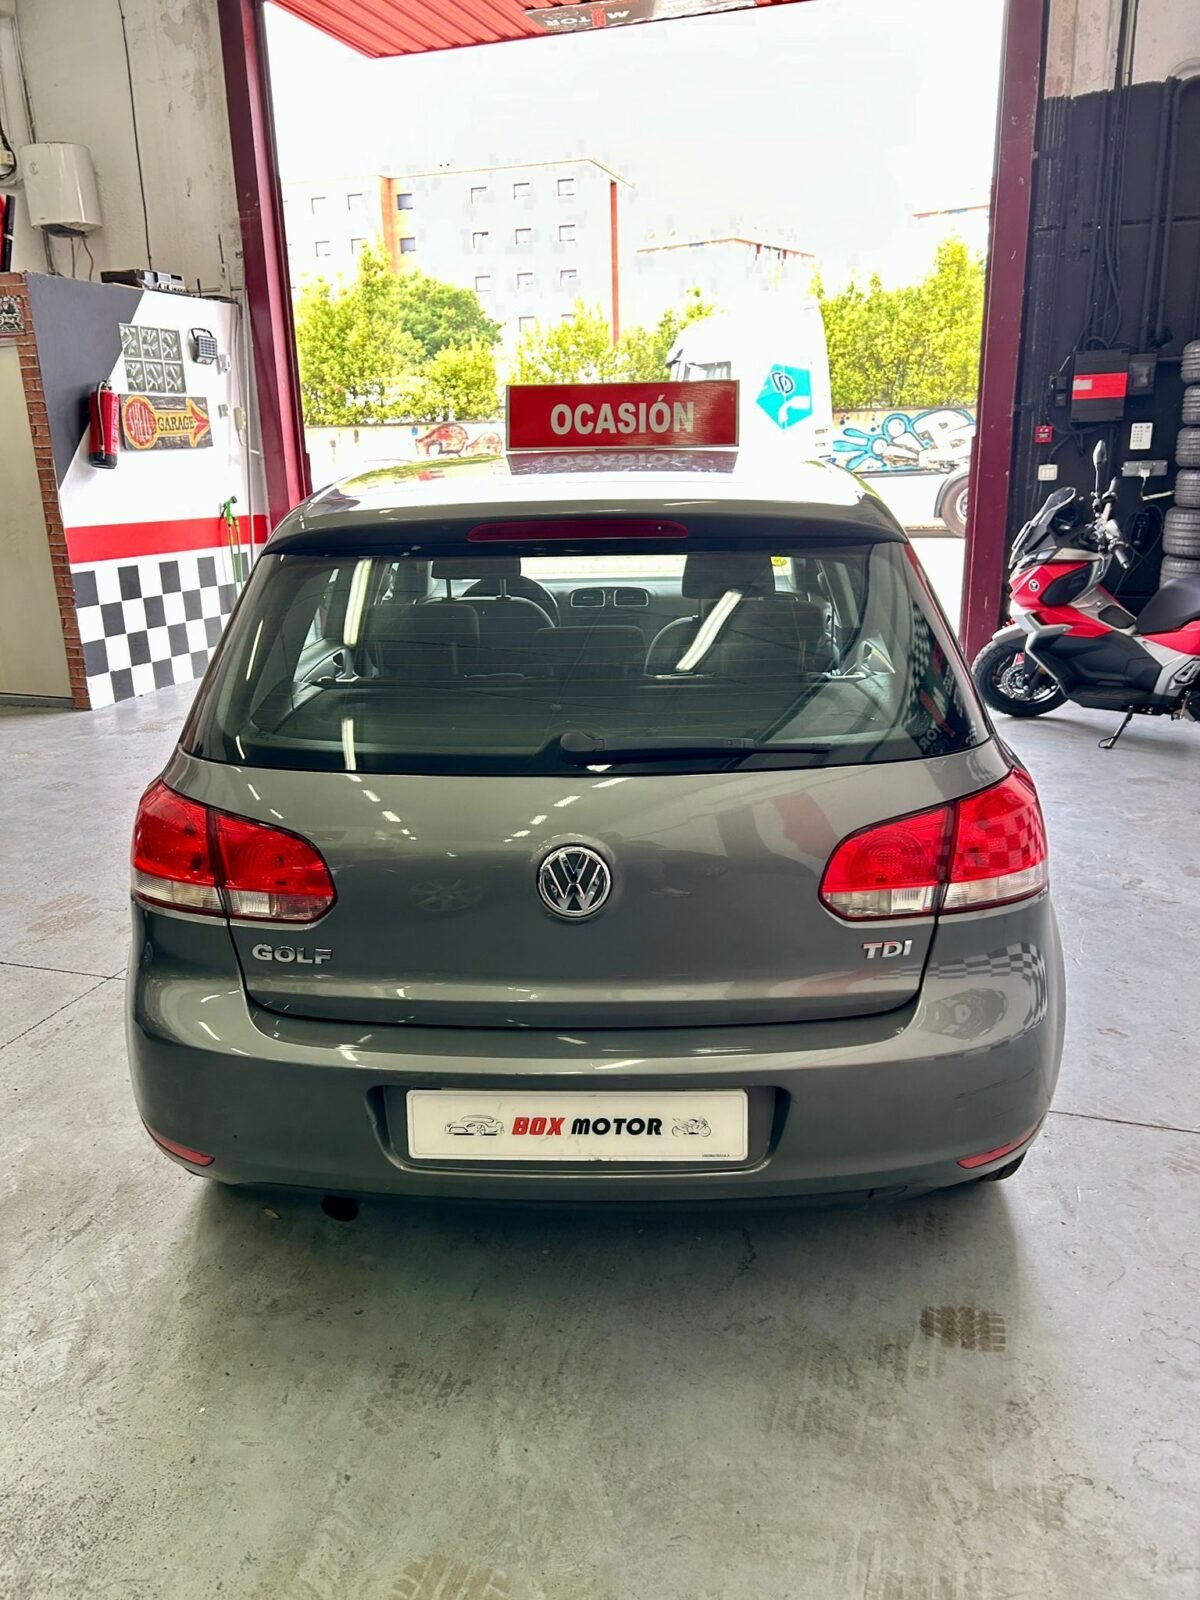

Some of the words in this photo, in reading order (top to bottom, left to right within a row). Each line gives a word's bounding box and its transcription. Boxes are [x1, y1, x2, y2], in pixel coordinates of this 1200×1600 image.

[157, 415, 195, 431] GARAGE
[550, 394, 695, 435] OCASIÓN
[252, 943, 332, 965] GOLF
[863, 940, 913, 959] TDI
[512, 1117, 565, 1135] BOX
[571, 1117, 663, 1136] MOTOR
